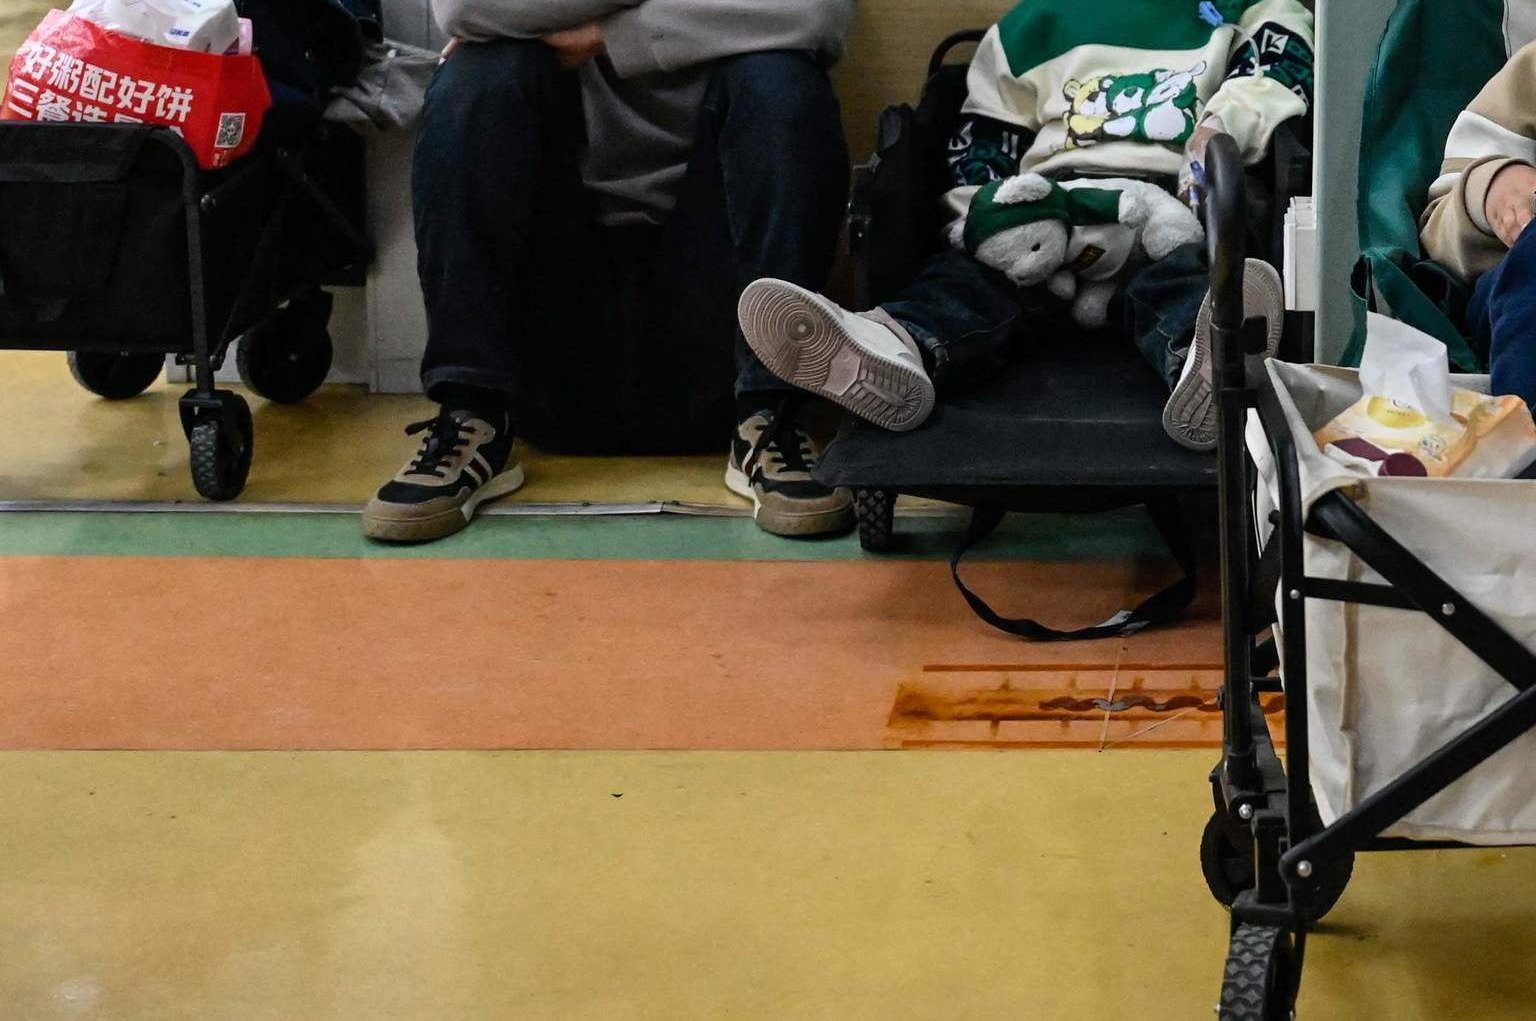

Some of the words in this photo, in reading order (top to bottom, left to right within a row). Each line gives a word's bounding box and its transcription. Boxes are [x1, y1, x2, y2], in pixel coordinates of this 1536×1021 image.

[21, 44, 194, 123] 好粥配好饼
